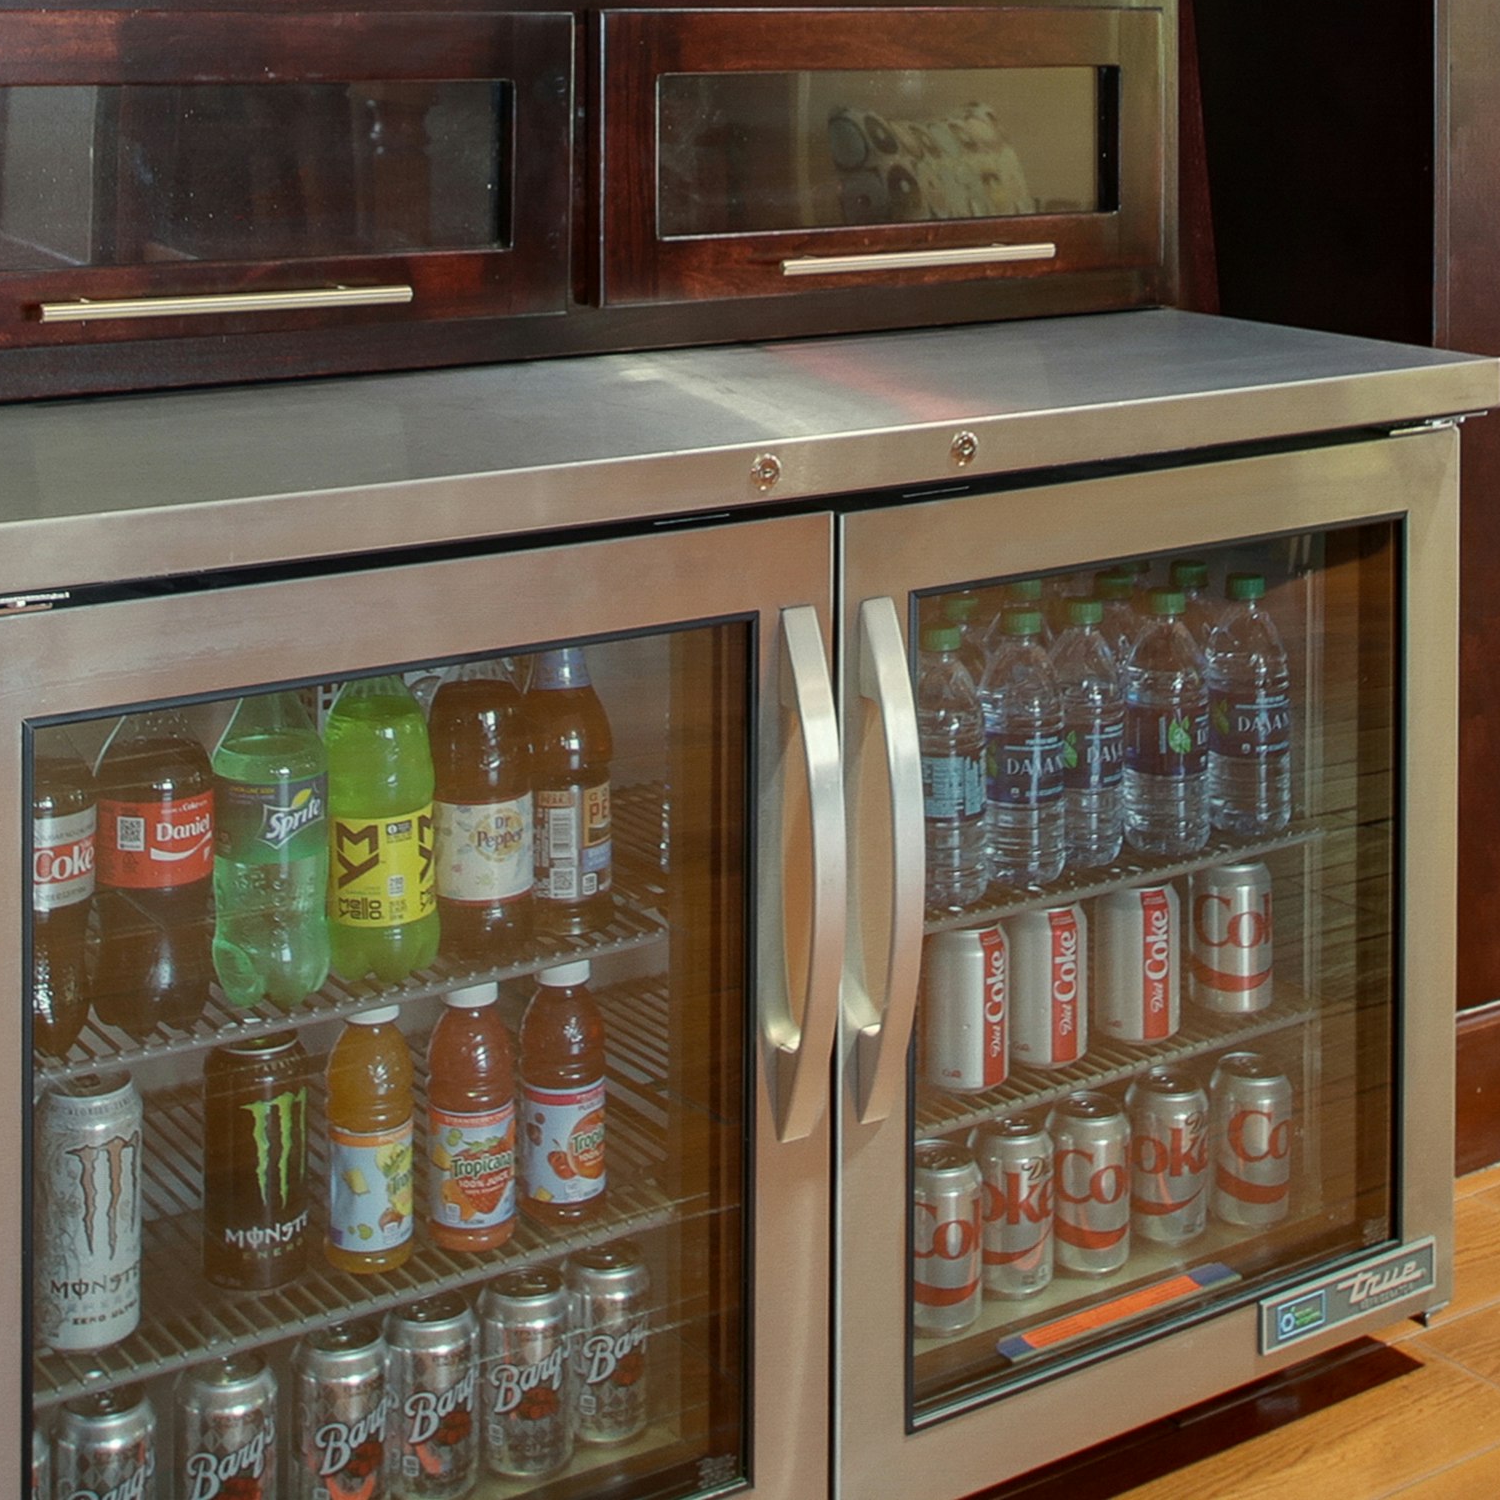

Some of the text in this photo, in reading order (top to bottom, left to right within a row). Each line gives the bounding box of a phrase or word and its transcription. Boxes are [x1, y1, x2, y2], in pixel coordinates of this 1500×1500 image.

[156, 813, 211, 842] Daniel
[265, 798, 321, 840] Sprite
[494, 815, 511, 830] Dr
[33, 845, 95, 882] Coke
[1145, 910, 1169, 981] Coke
[1053, 931, 1077, 1002] Coke
[985, 950, 1005, 1024] Coke
[450, 1150, 514, 1178] Tropicana
[225, 1209, 309, 1249] MONST
[50, 1260, 141, 1300] MONST
